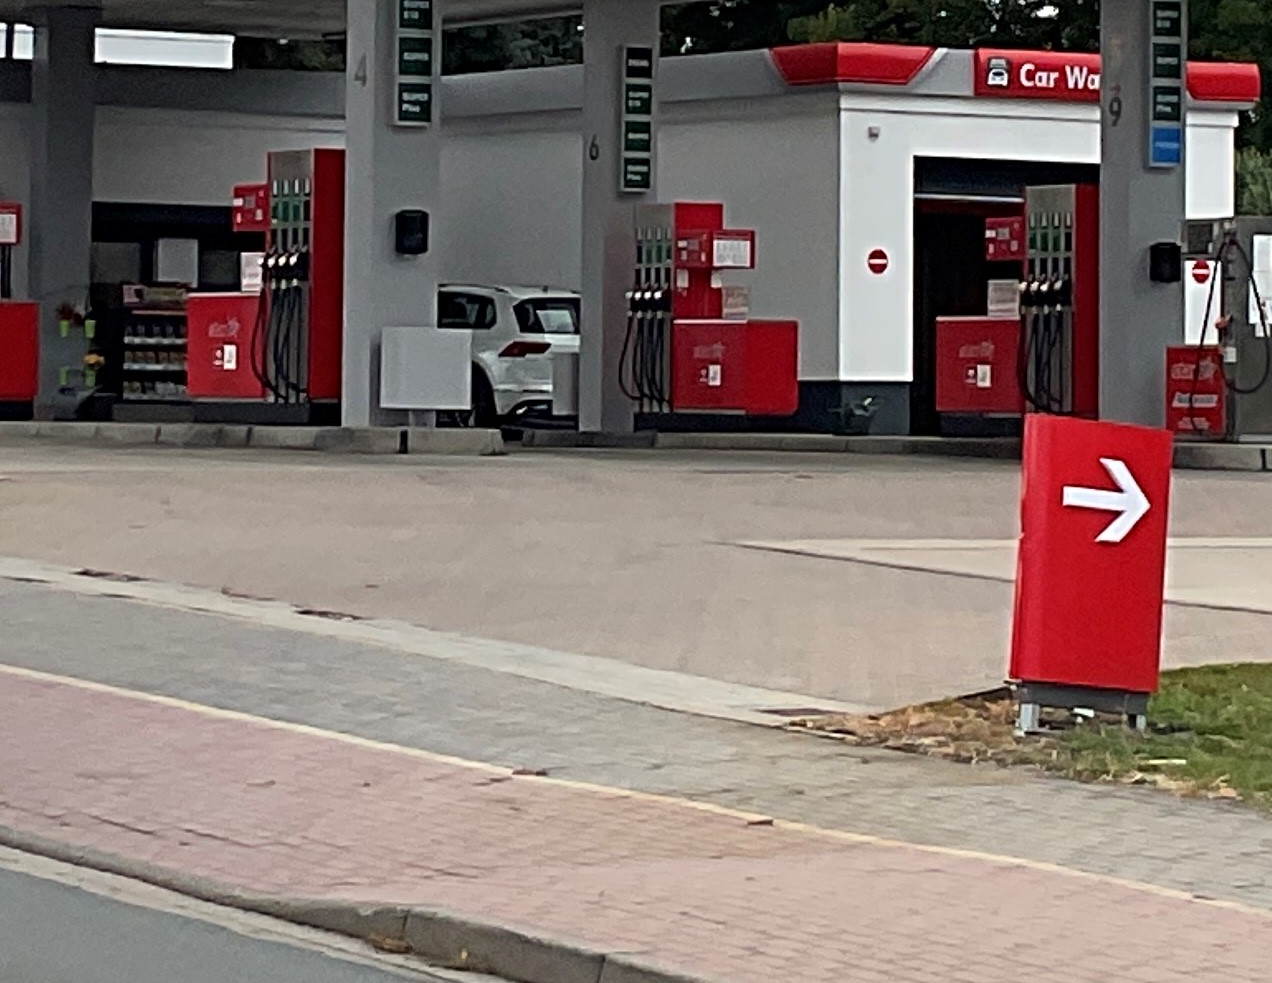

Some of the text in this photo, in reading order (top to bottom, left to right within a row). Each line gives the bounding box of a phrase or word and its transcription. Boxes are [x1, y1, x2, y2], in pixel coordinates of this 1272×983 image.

[354, 54, 367, 87] 4
[1020, 63, 1101, 90] Car Wa
[1109, 97, 1122, 127] 9
[589, 134, 600, 161] 6
